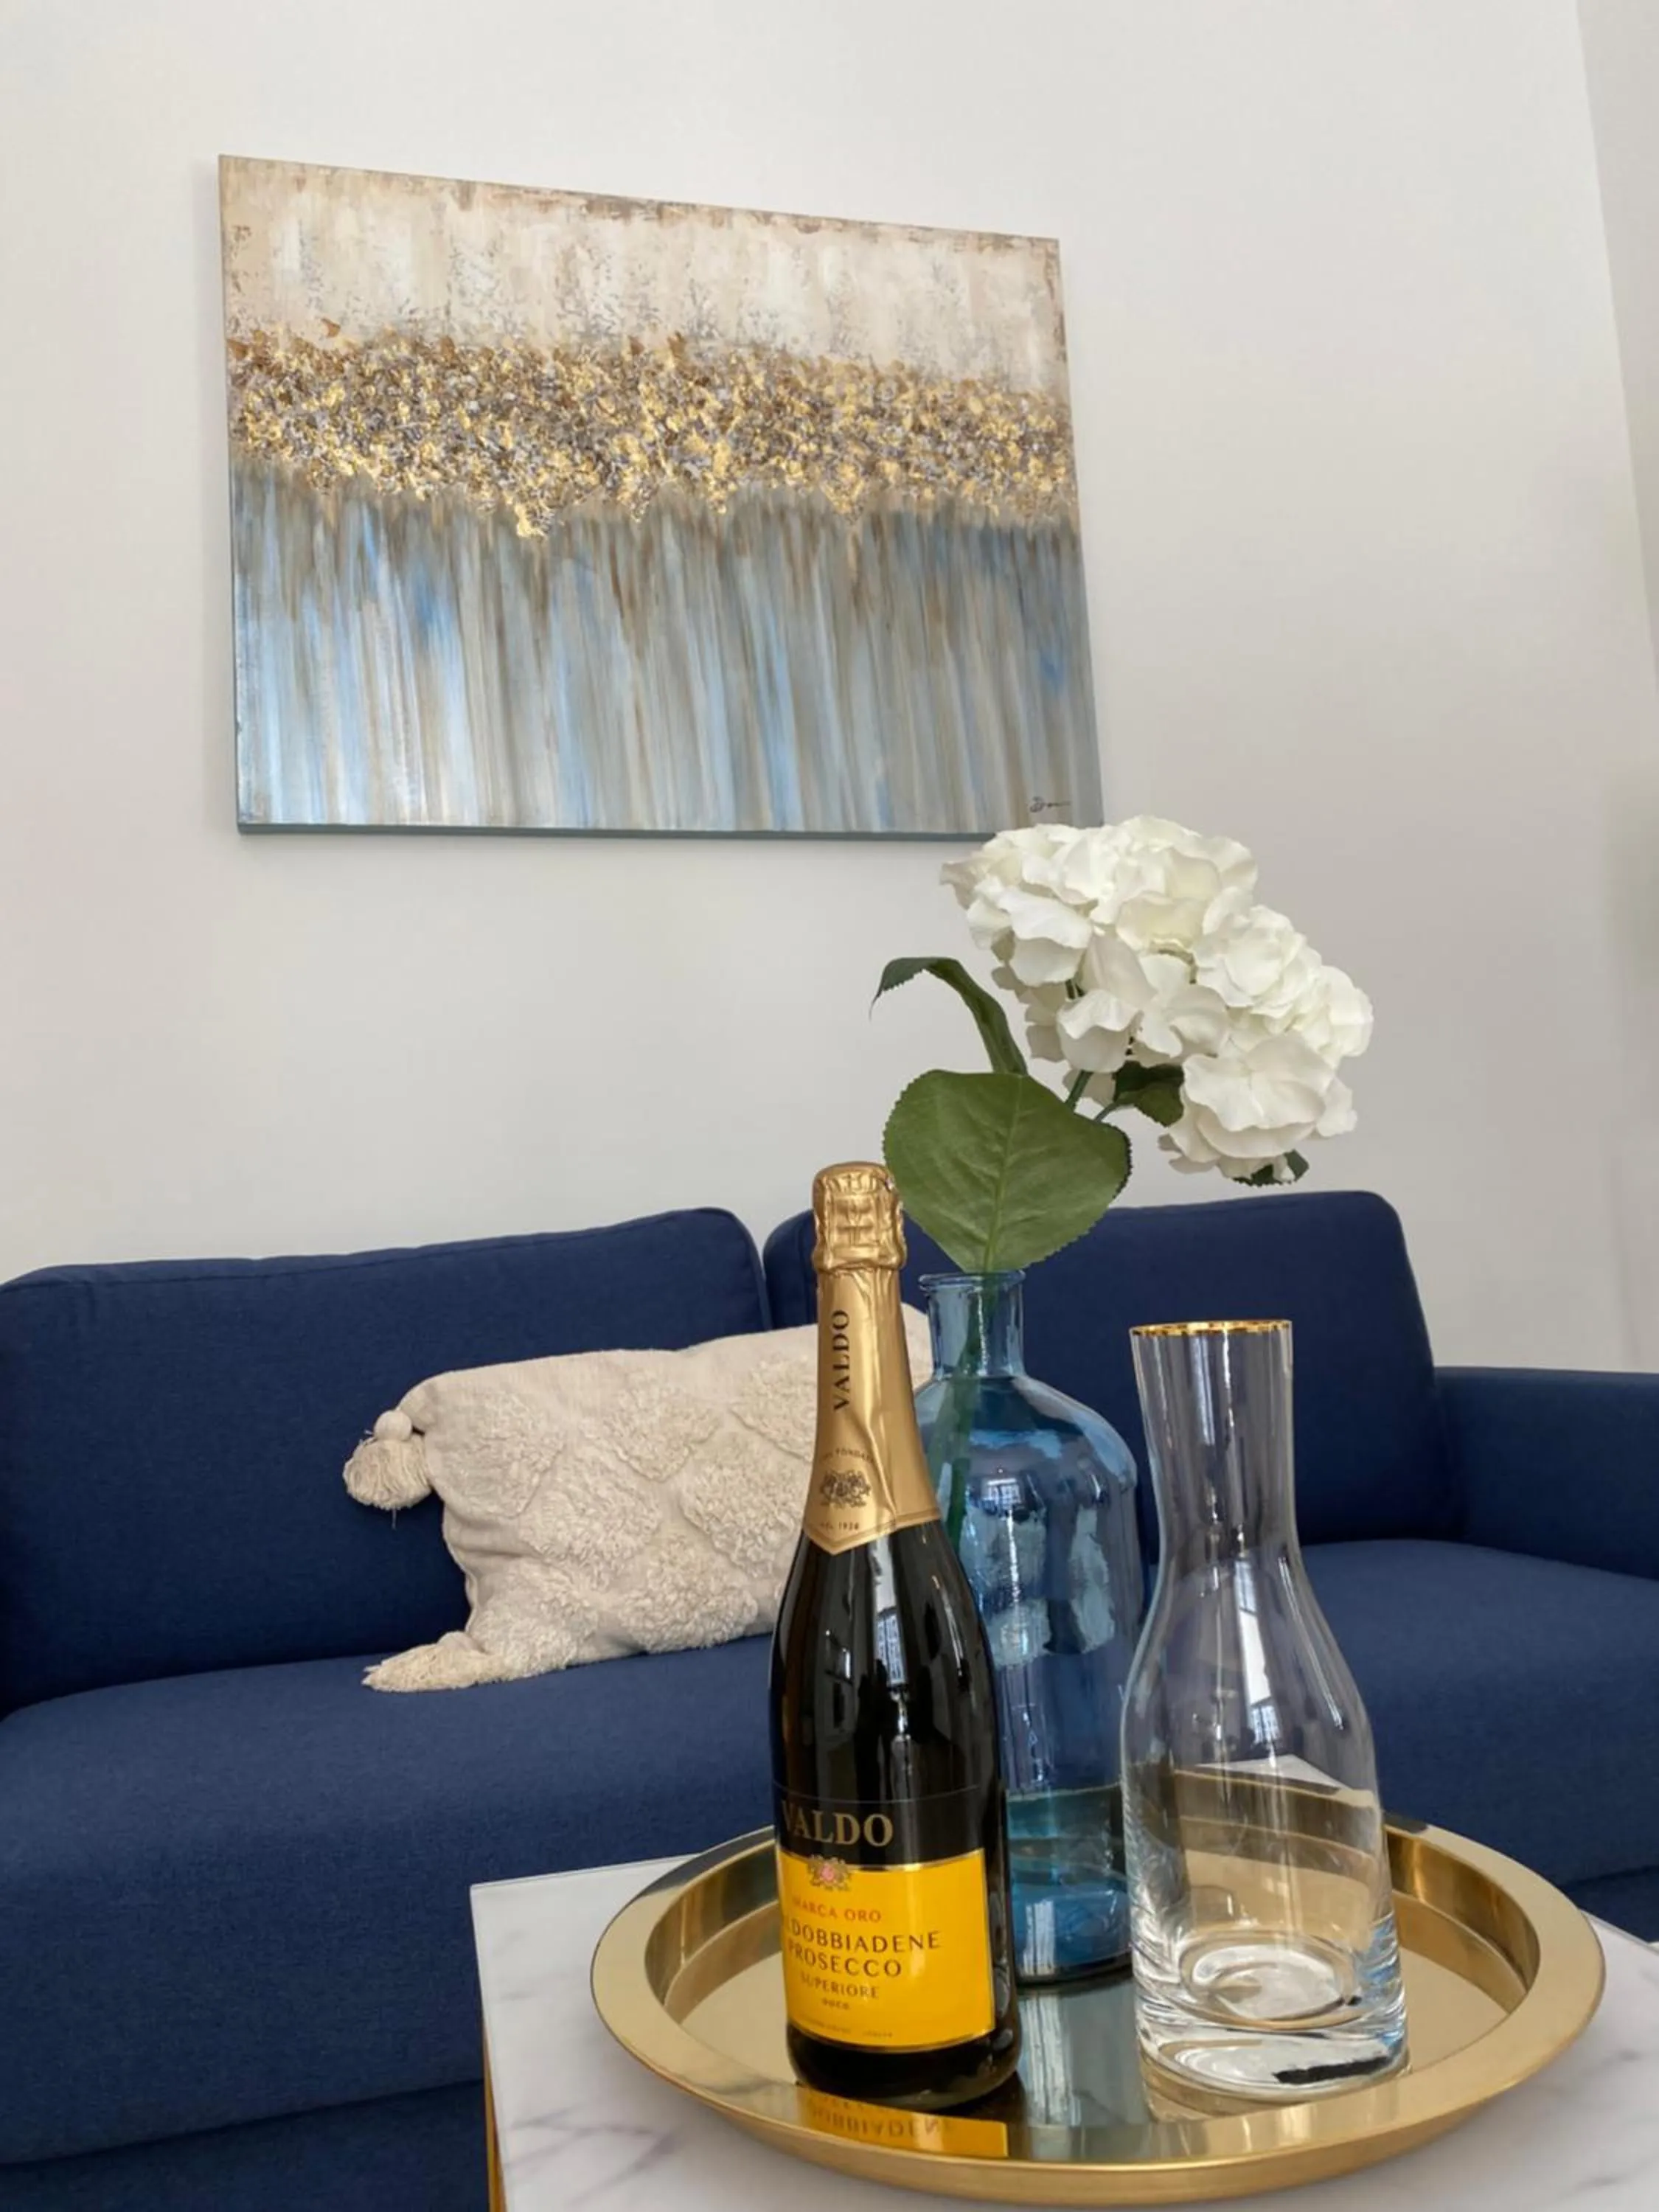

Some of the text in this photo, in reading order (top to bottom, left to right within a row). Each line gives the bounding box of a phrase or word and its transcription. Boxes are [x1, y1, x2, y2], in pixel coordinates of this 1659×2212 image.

[832, 1310, 850, 1411] VALDO
[792, 1895, 882, 1924] MARCA ORO
[787, 1917, 942, 1955] DOBBIADENE
[787, 1937, 902, 1978] PROSECCO
[800, 1970, 880, 2000] SUPERIORE
